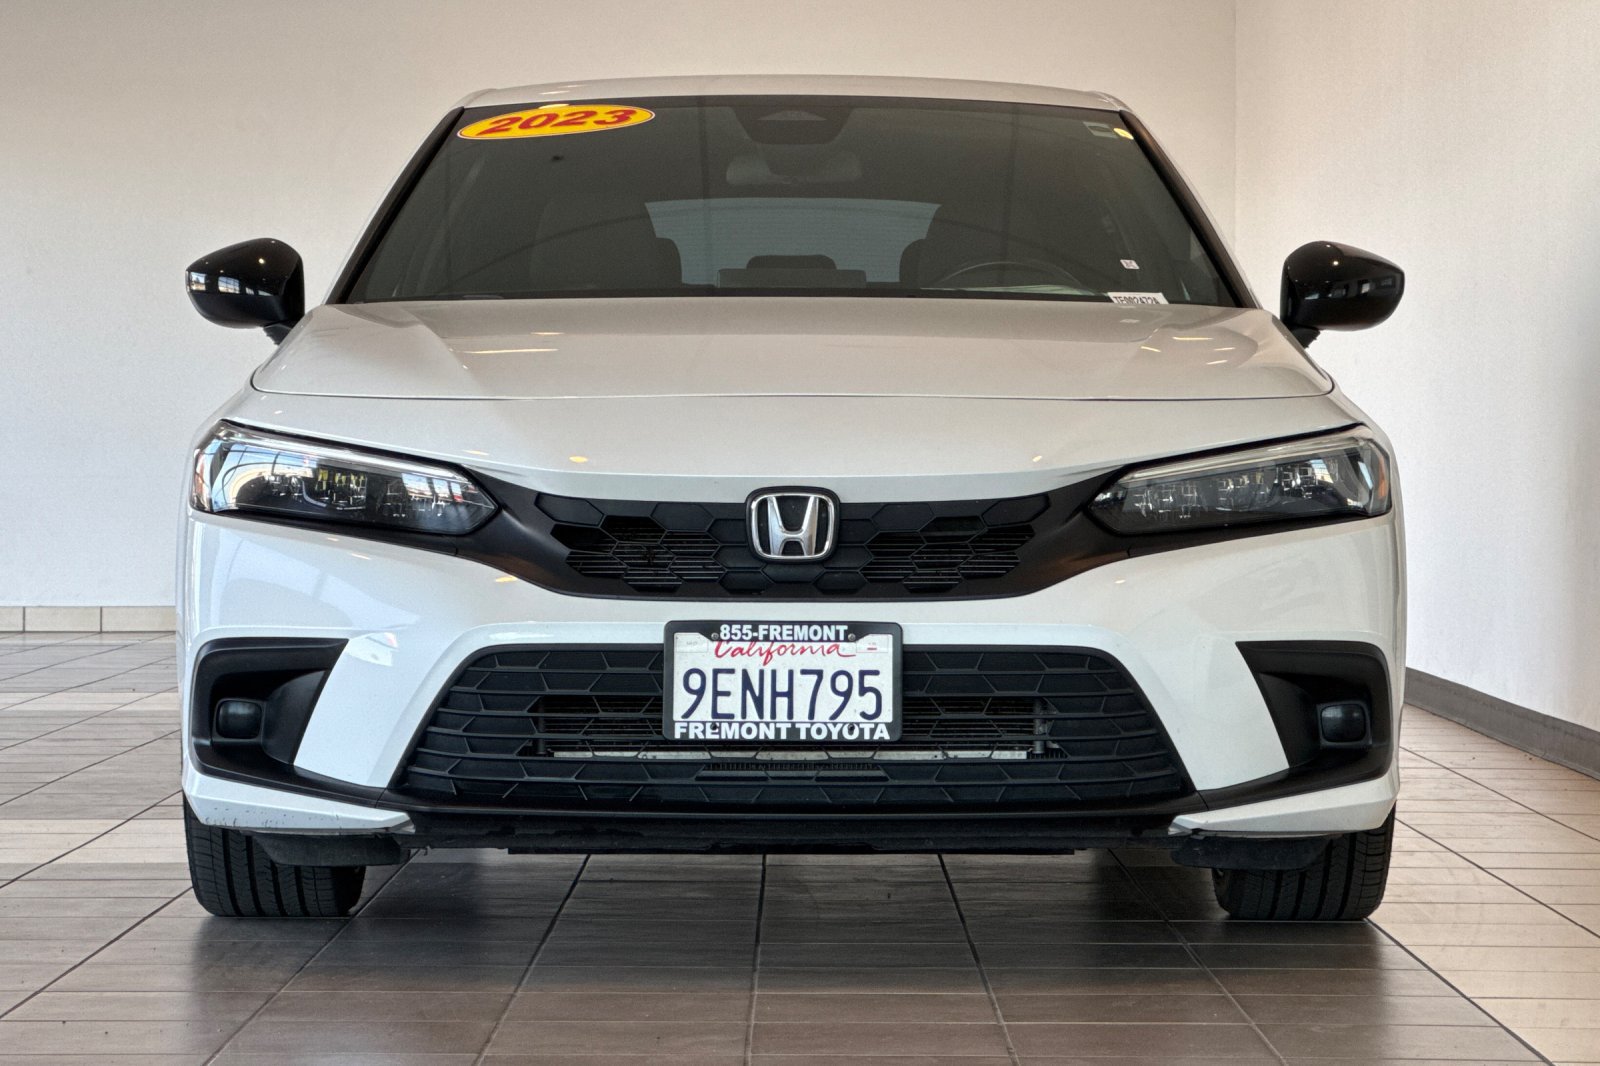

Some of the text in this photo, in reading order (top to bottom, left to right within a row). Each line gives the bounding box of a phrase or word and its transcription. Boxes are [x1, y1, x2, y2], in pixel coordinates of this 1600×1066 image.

[475, 109, 637, 137] 2023
[719, 624, 848, 641] 855-FREMONT
[714, 641, 856, 666] California
[681, 667, 883, 721] 9ENH795
[674, 722, 891, 740] FREMONT TOYOTA
